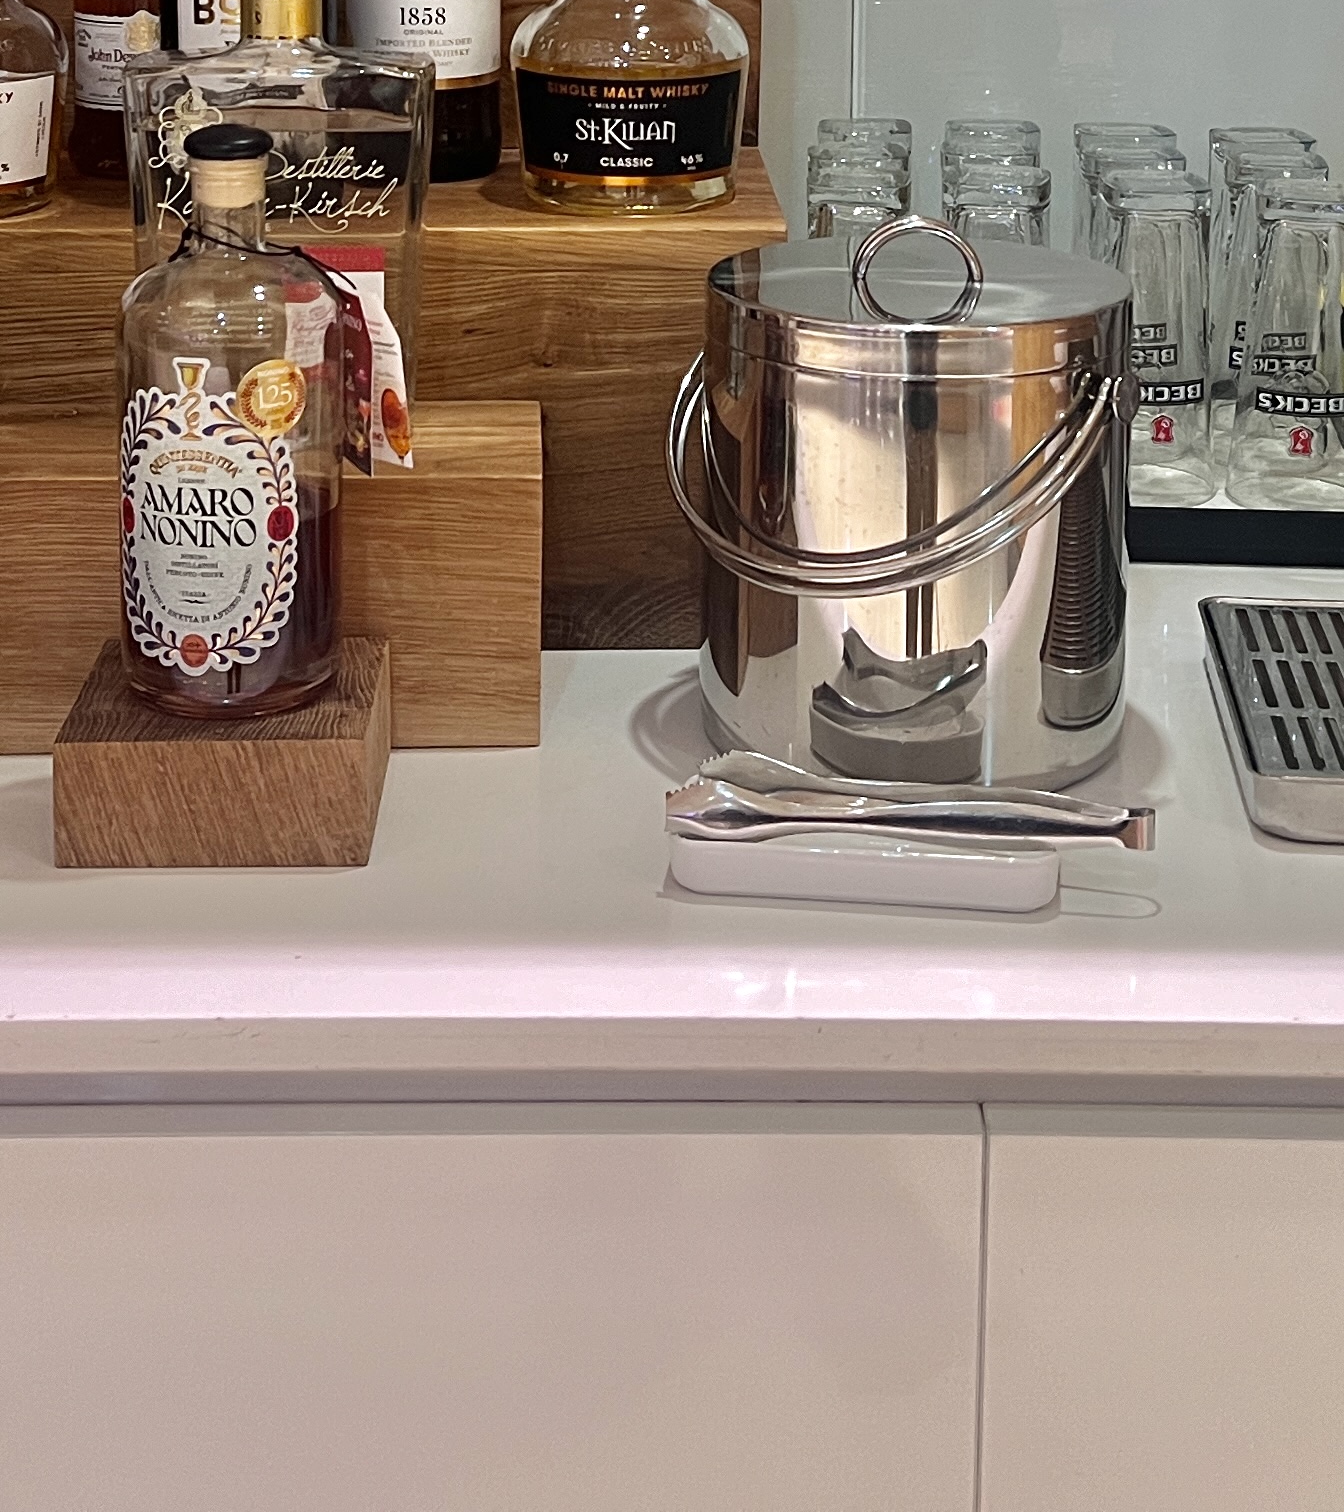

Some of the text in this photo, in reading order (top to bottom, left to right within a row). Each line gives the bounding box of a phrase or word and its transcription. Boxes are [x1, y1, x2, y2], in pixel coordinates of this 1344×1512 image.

[399, 6, 447, 26] 1858
[603, 87, 645, 99] MALT
[650, 83, 709, 98] WHISKY
[599, 157, 654, 167] CLASSIC
[141, 481, 255, 519] AMARO
[140, 511, 257, 547] NONINO
